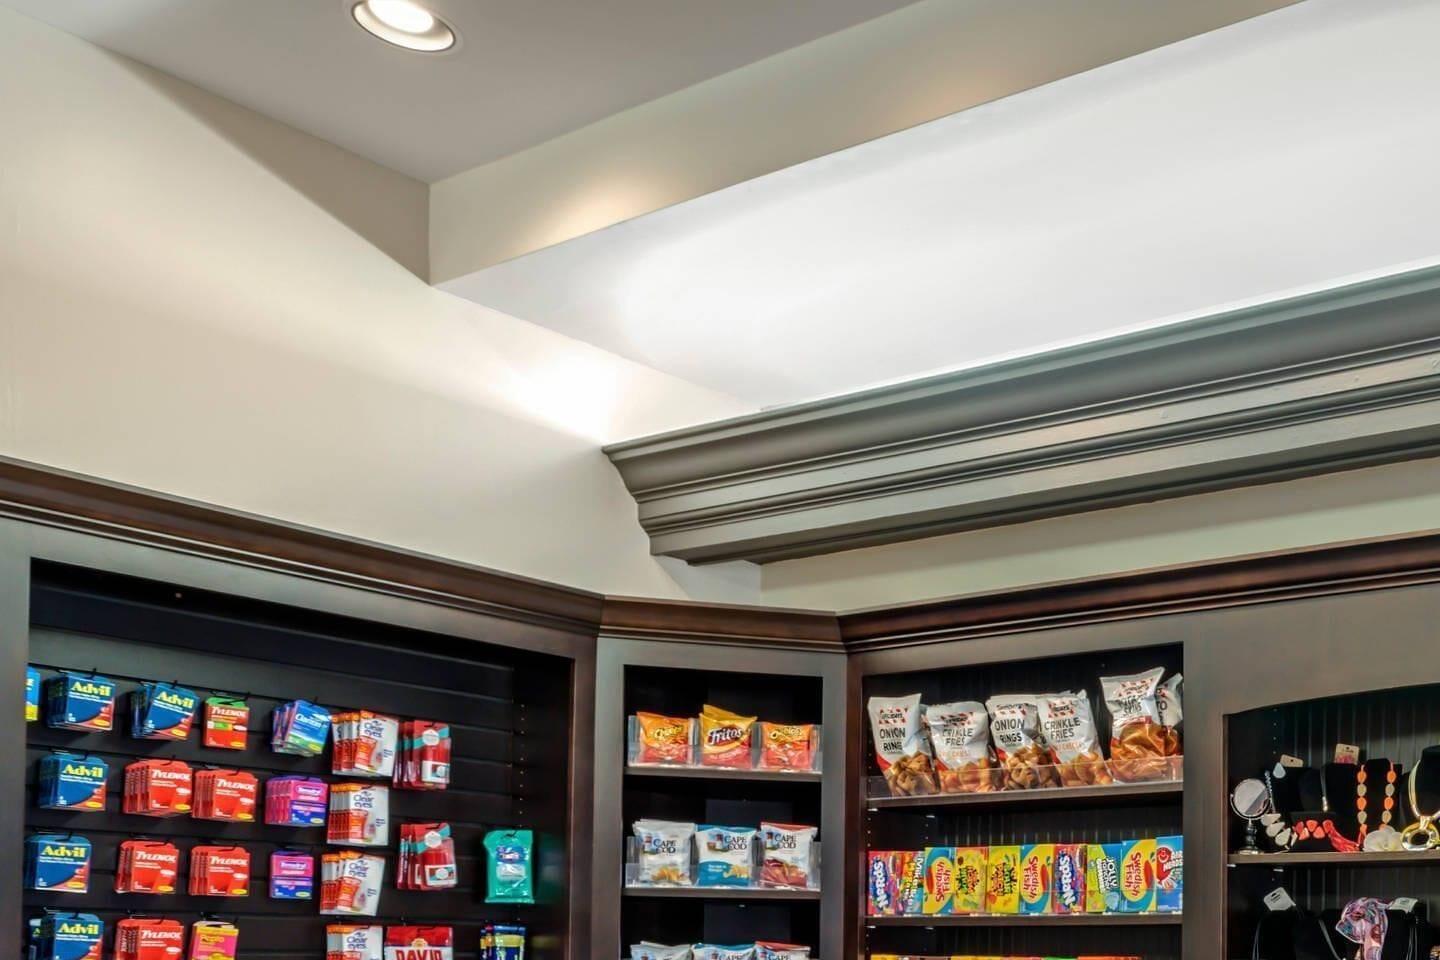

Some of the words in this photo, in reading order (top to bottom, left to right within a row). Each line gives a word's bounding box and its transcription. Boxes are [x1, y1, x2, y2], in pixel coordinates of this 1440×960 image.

[71, 682, 110, 696] Advil
[156, 691, 193, 708] Advil
[363, 722, 384, 735] Clear
[995, 719, 1025, 731] ONION
[1044, 717, 1080, 730] CRINKLE
[709, 727, 743, 744] Fritos
[879, 728, 905, 738] ONION
[1000, 733, 1022, 743] RINGS
[1050, 728, 1074, 740] FRIES
[63, 764, 103, 778] Advil
[152, 770, 190, 781] TYLENOL
[217, 779, 254, 791] TYLENOL
[353, 791, 374, 802] Clear
[653, 838, 676, 848] CAPE
[724, 835, 747, 844] CAPE
[774, 833, 796, 842] CAPE
[656, 845, 676, 854] COD
[728, 842, 747, 850] COD
[776, 840, 796, 849] COD
[41, 845, 86, 857] Advil
[135, 851, 176, 862] TYLENOL
[210, 855, 248, 866] TYLENOL
[1029, 856, 1038, 899] Swedish
[1106, 857, 1117, 887] JOLLY
[1125, 865, 1133, 889] Fish
[1131, 852, 1141, 896] Swedish
[936, 861, 945, 902] Swedish
[943, 869, 951, 893] Fish
[1023, 867, 1031, 891] Fish
[1059, 854, 1076, 906] Nerds
[59, 923, 99, 935] Advil
[141, 930, 182, 939] TYLENOL
[346, 936, 368, 944] Clear
